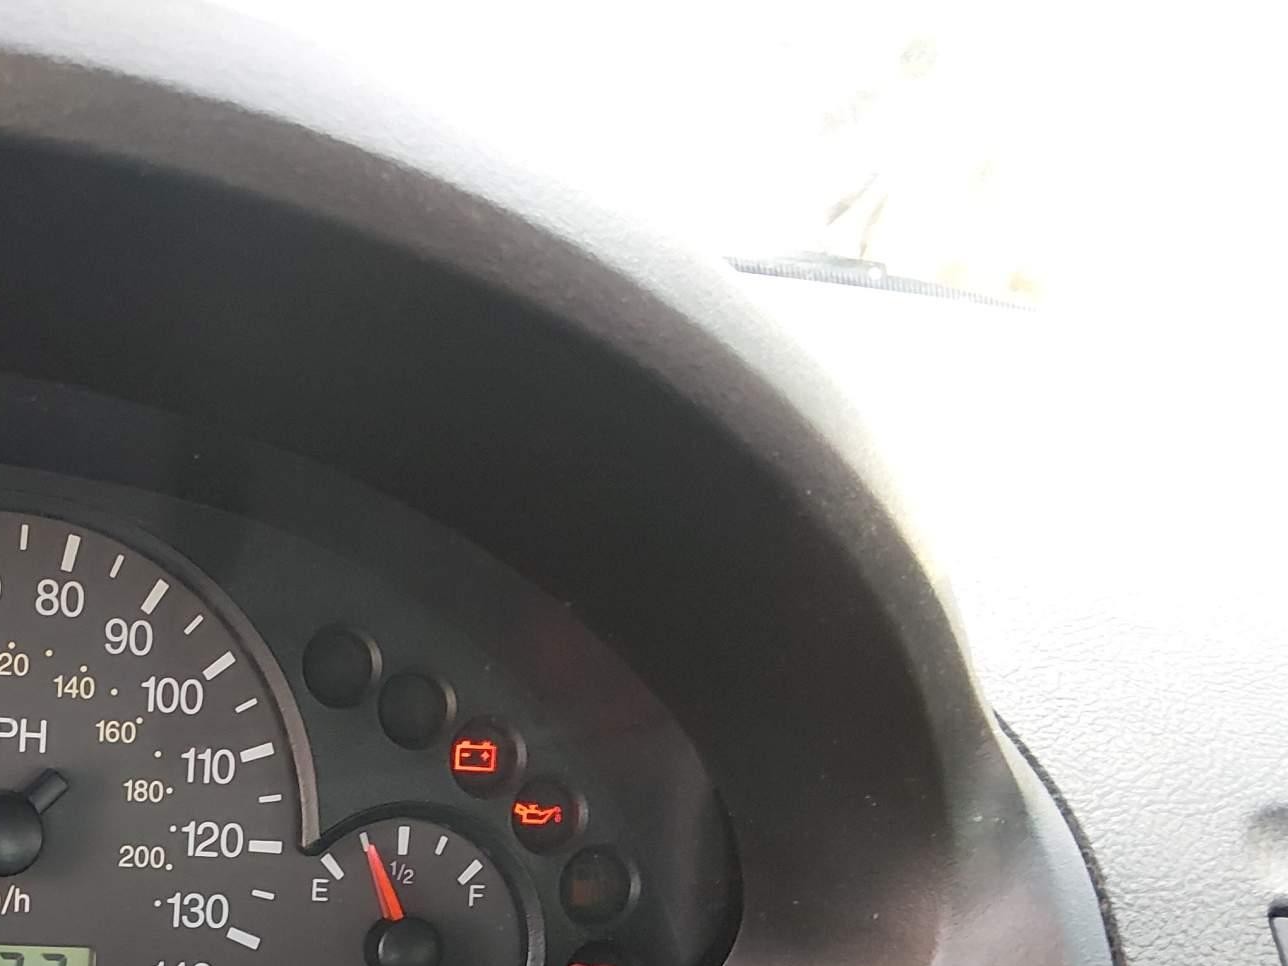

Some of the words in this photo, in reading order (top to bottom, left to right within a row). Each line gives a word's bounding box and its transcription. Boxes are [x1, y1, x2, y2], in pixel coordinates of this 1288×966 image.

[35, 578, 85, 618] 80
[104, 617, 153, 656] 90
[53, 674, 95, 700] 140
[140, 675, 204, 715] 100
[95, 719, 137, 744] 160
[180, 747, 236, 785] 110
[123, 779, 164, 803] 180
[181, 820, 244, 858] 120
[312, 878, 329, 902] E
[468, 884, 486, 907] F
[166, 892, 229, 929] 130
